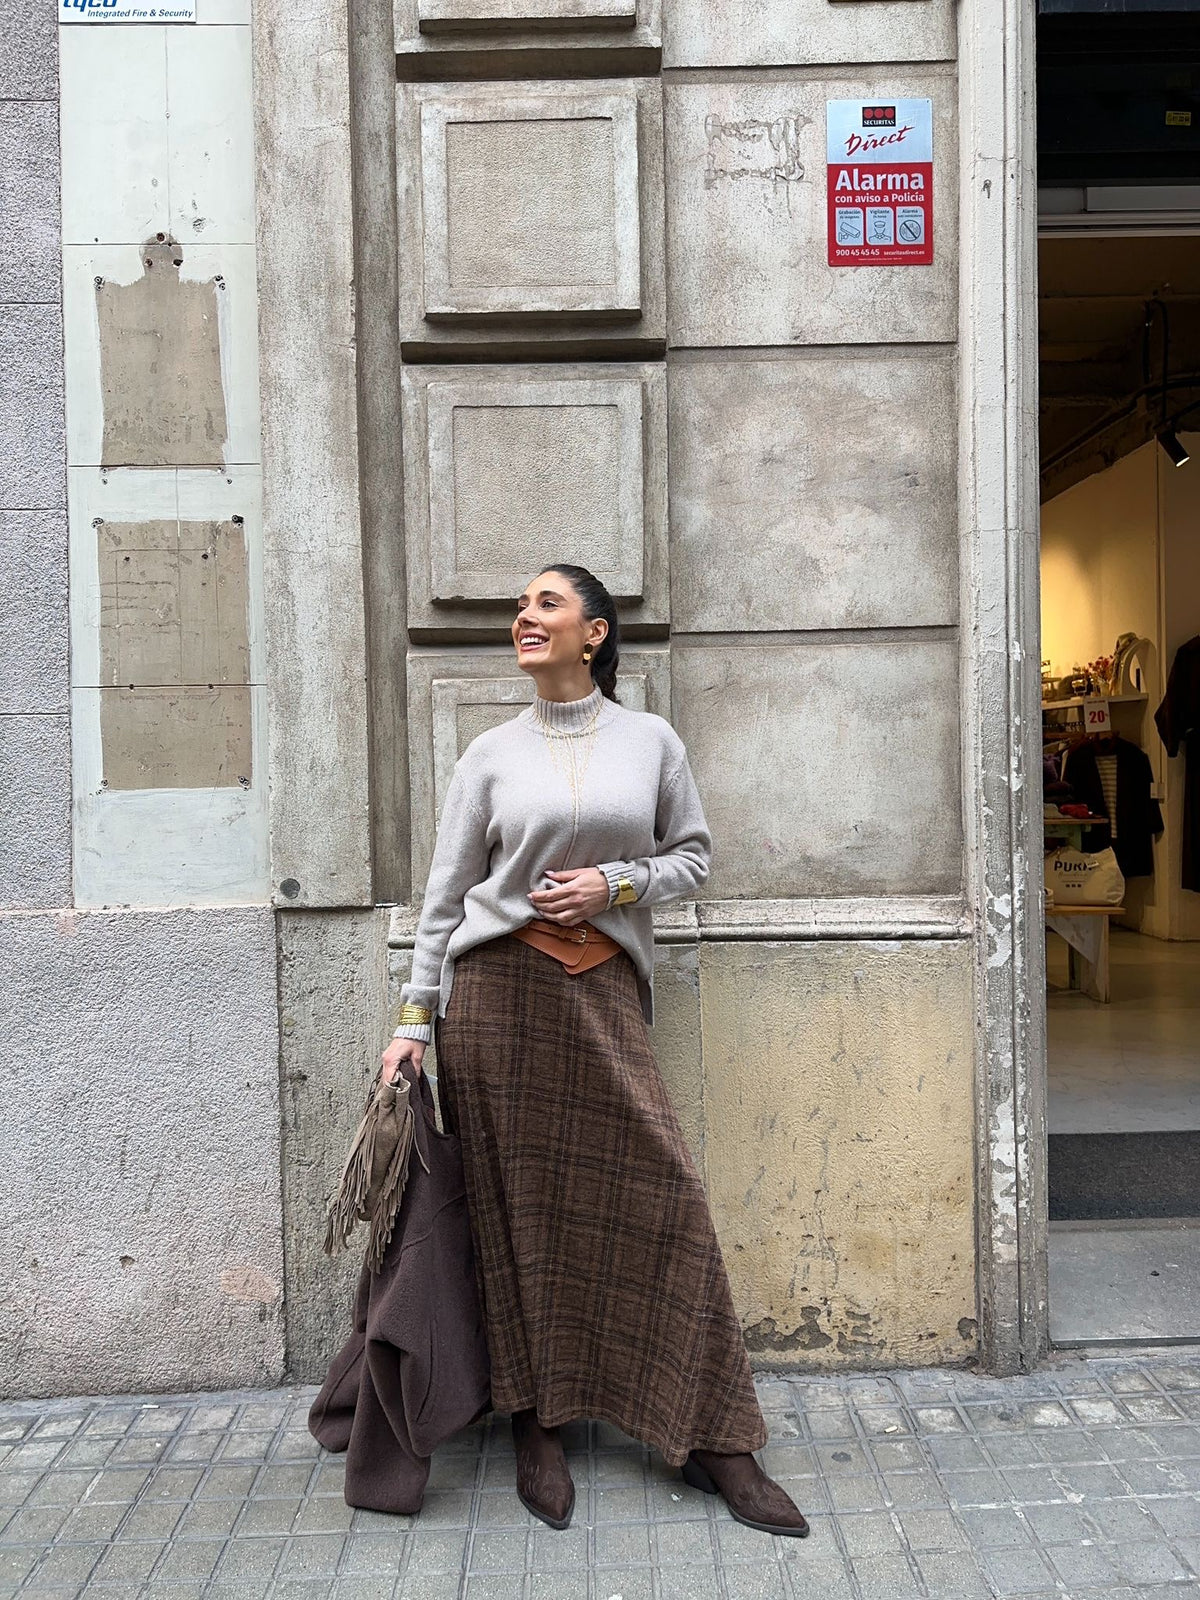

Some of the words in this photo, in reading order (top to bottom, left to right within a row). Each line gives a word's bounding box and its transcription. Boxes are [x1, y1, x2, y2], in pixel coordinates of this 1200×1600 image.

[87, 9, 130, 18] Integrated
[132, 9, 147, 17] Fire
[149, 9, 157, 17] &
[158, 9, 193, 18] Security
[844, 125, 915, 157] Direct
[835, 168, 925, 191] Alarma
[835, 195, 853, 203] con
[855, 193, 881, 203] aviso
[891, 191, 925, 202] Policía
[835, 249, 850, 257] 900
[860, 248, 870, 256] 45
[870, 248, 880, 256] 45
